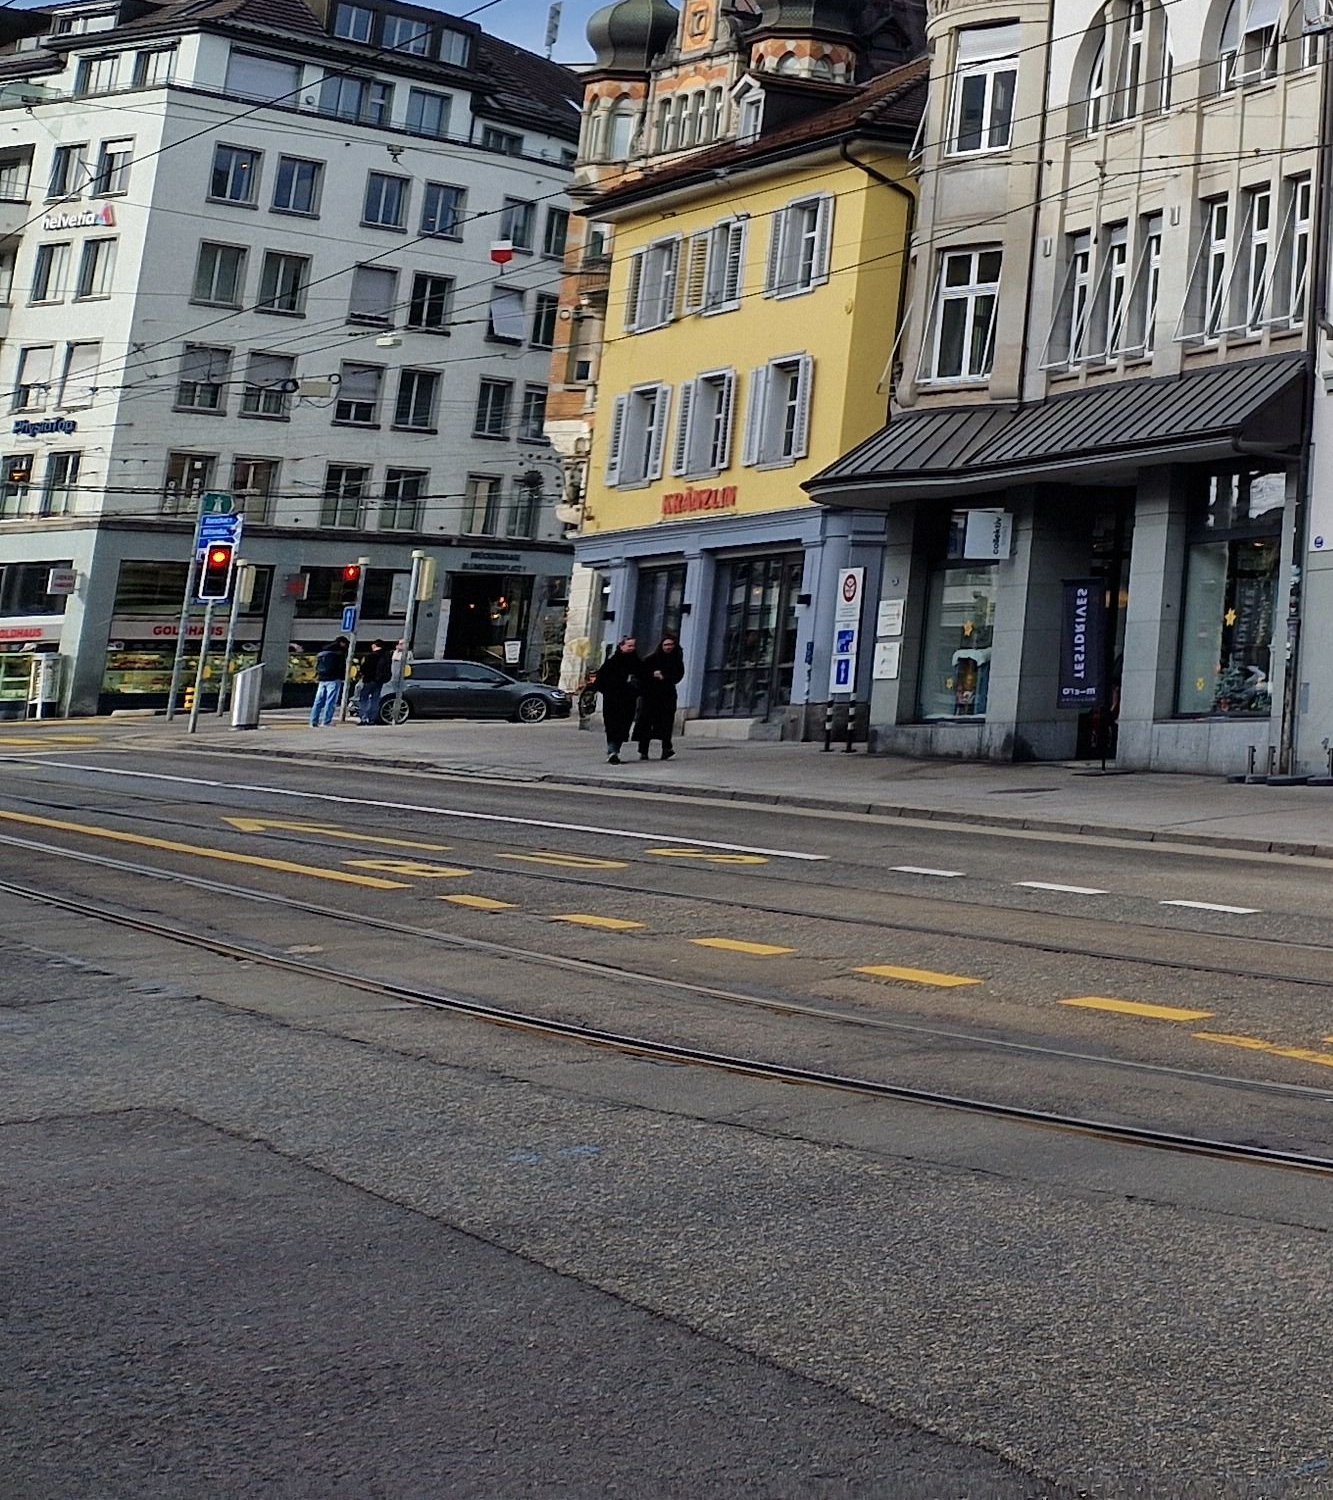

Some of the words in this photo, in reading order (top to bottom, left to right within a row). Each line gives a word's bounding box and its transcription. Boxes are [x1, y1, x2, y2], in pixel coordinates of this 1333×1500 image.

[42, 211, 95, 230] helvetia
[662, 486, 738, 515] KRÄNZLIN
[153, 626, 223, 636] GOLHAS
